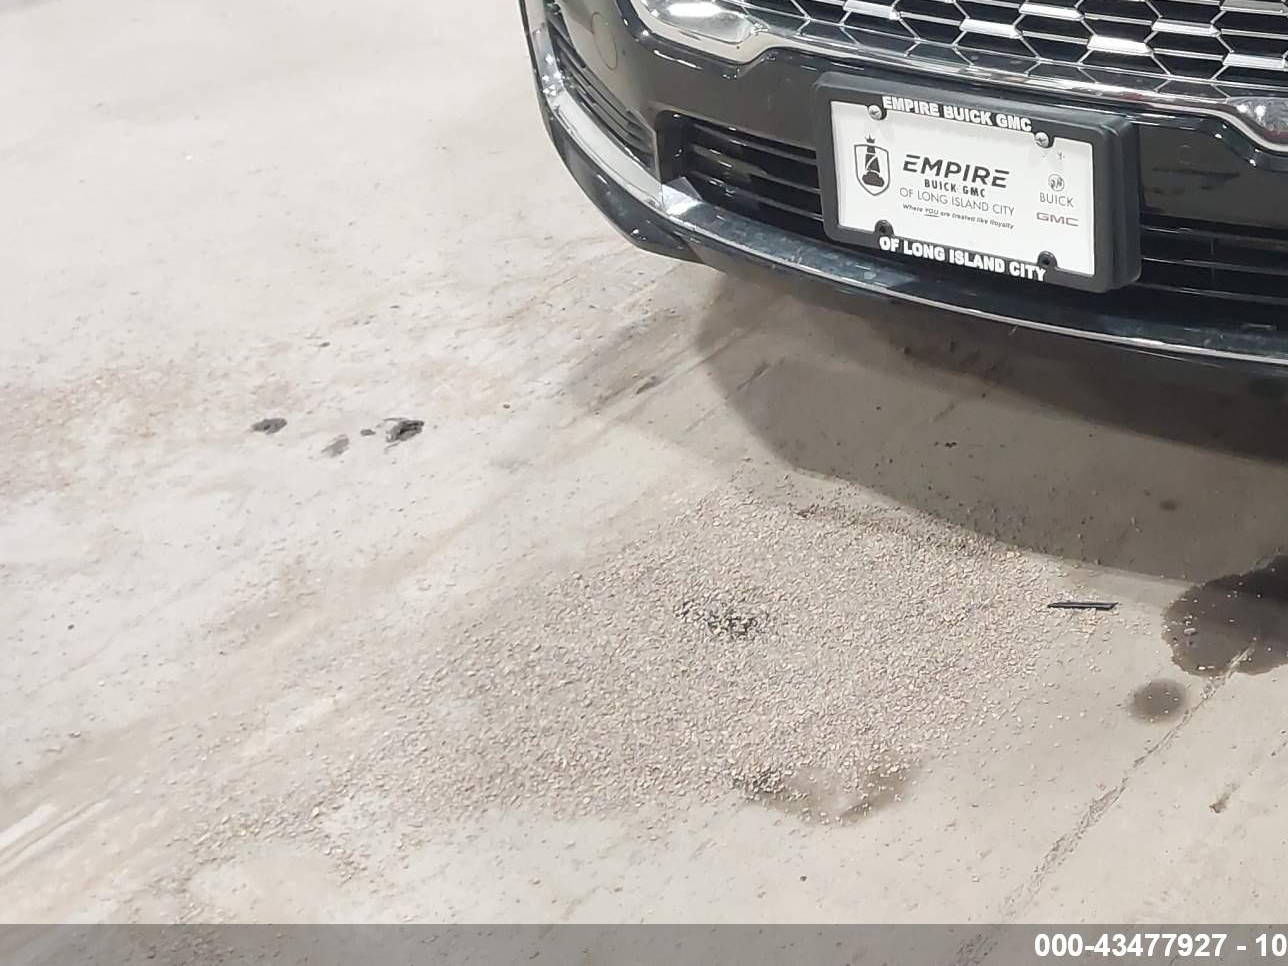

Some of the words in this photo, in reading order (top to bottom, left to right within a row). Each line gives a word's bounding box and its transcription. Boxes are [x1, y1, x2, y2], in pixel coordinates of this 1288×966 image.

[881, 95, 940, 117] EMPIRE
[943, 105, 994, 126] BUICK
[996, 112, 1033, 132] GMC
[902, 153, 1010, 189] EMPIRE
[899, 187, 913, 198] OF
[917, 189, 949, 204] LONG
[952, 196, 989, 212] ISLAND
[992, 203, 1015, 217] CITY
[923, 178, 957, 193] BUICK
[962, 185, 986, 198] GMC
[1039, 192, 1074, 208] BUICK
[1036, 211, 1079, 227] GMC
[878, 236, 900, 252] OF
[903, 240, 945, 262] LONG
[948, 249, 1006, 274] ISLAND
[1009, 261, 1047, 282] CITY
